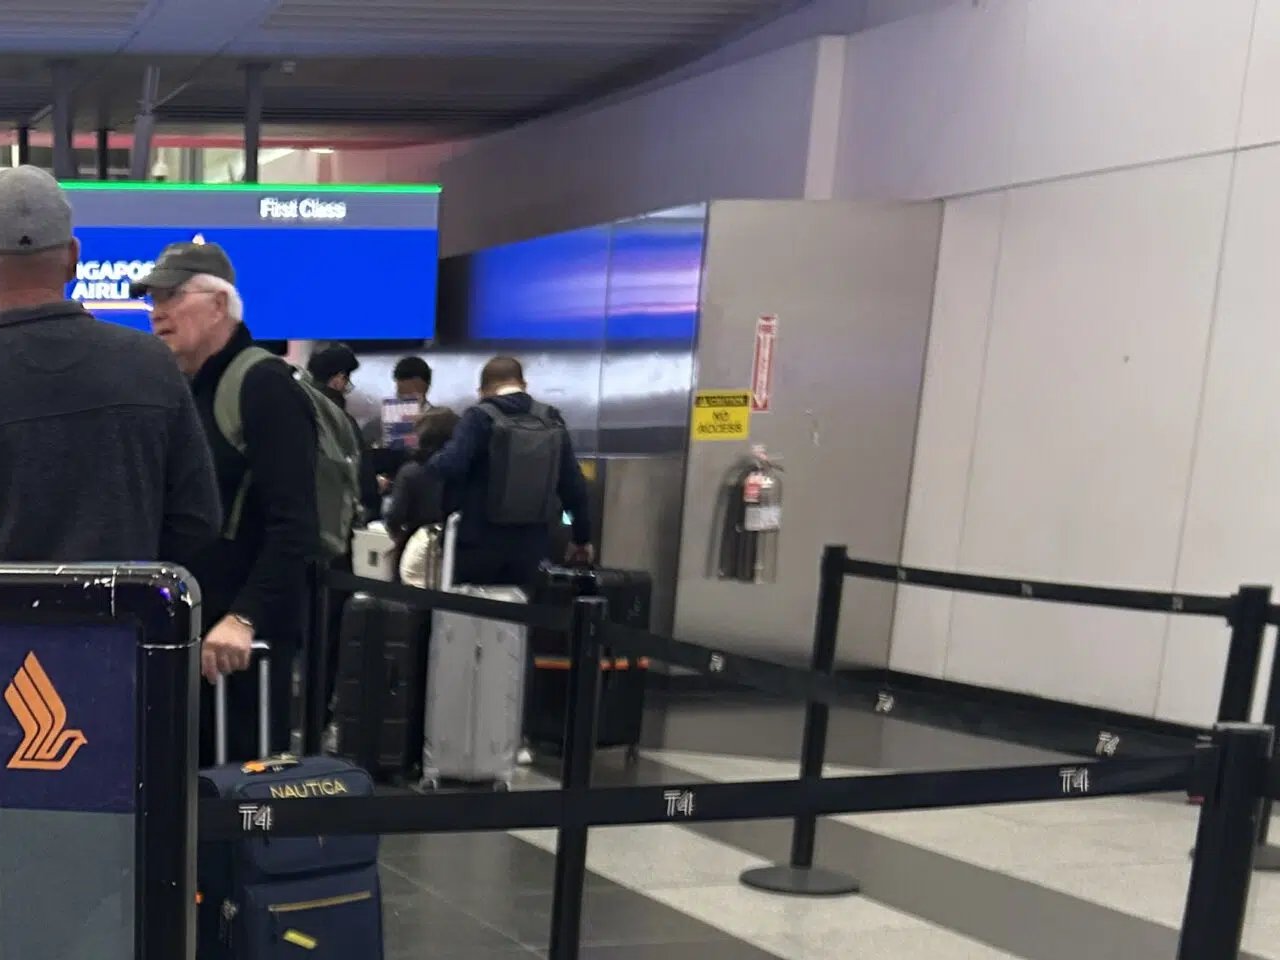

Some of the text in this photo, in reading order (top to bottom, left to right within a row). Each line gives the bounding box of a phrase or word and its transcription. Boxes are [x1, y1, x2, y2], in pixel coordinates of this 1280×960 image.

[260, 197, 346, 218] First Class
[70, 280, 131, 300] AIRLI
[270, 778, 347, 799] NAUTICA
[1059, 767, 1089, 793] T4
[664, 789, 695, 817] T4
[239, 803, 273, 831] T4
